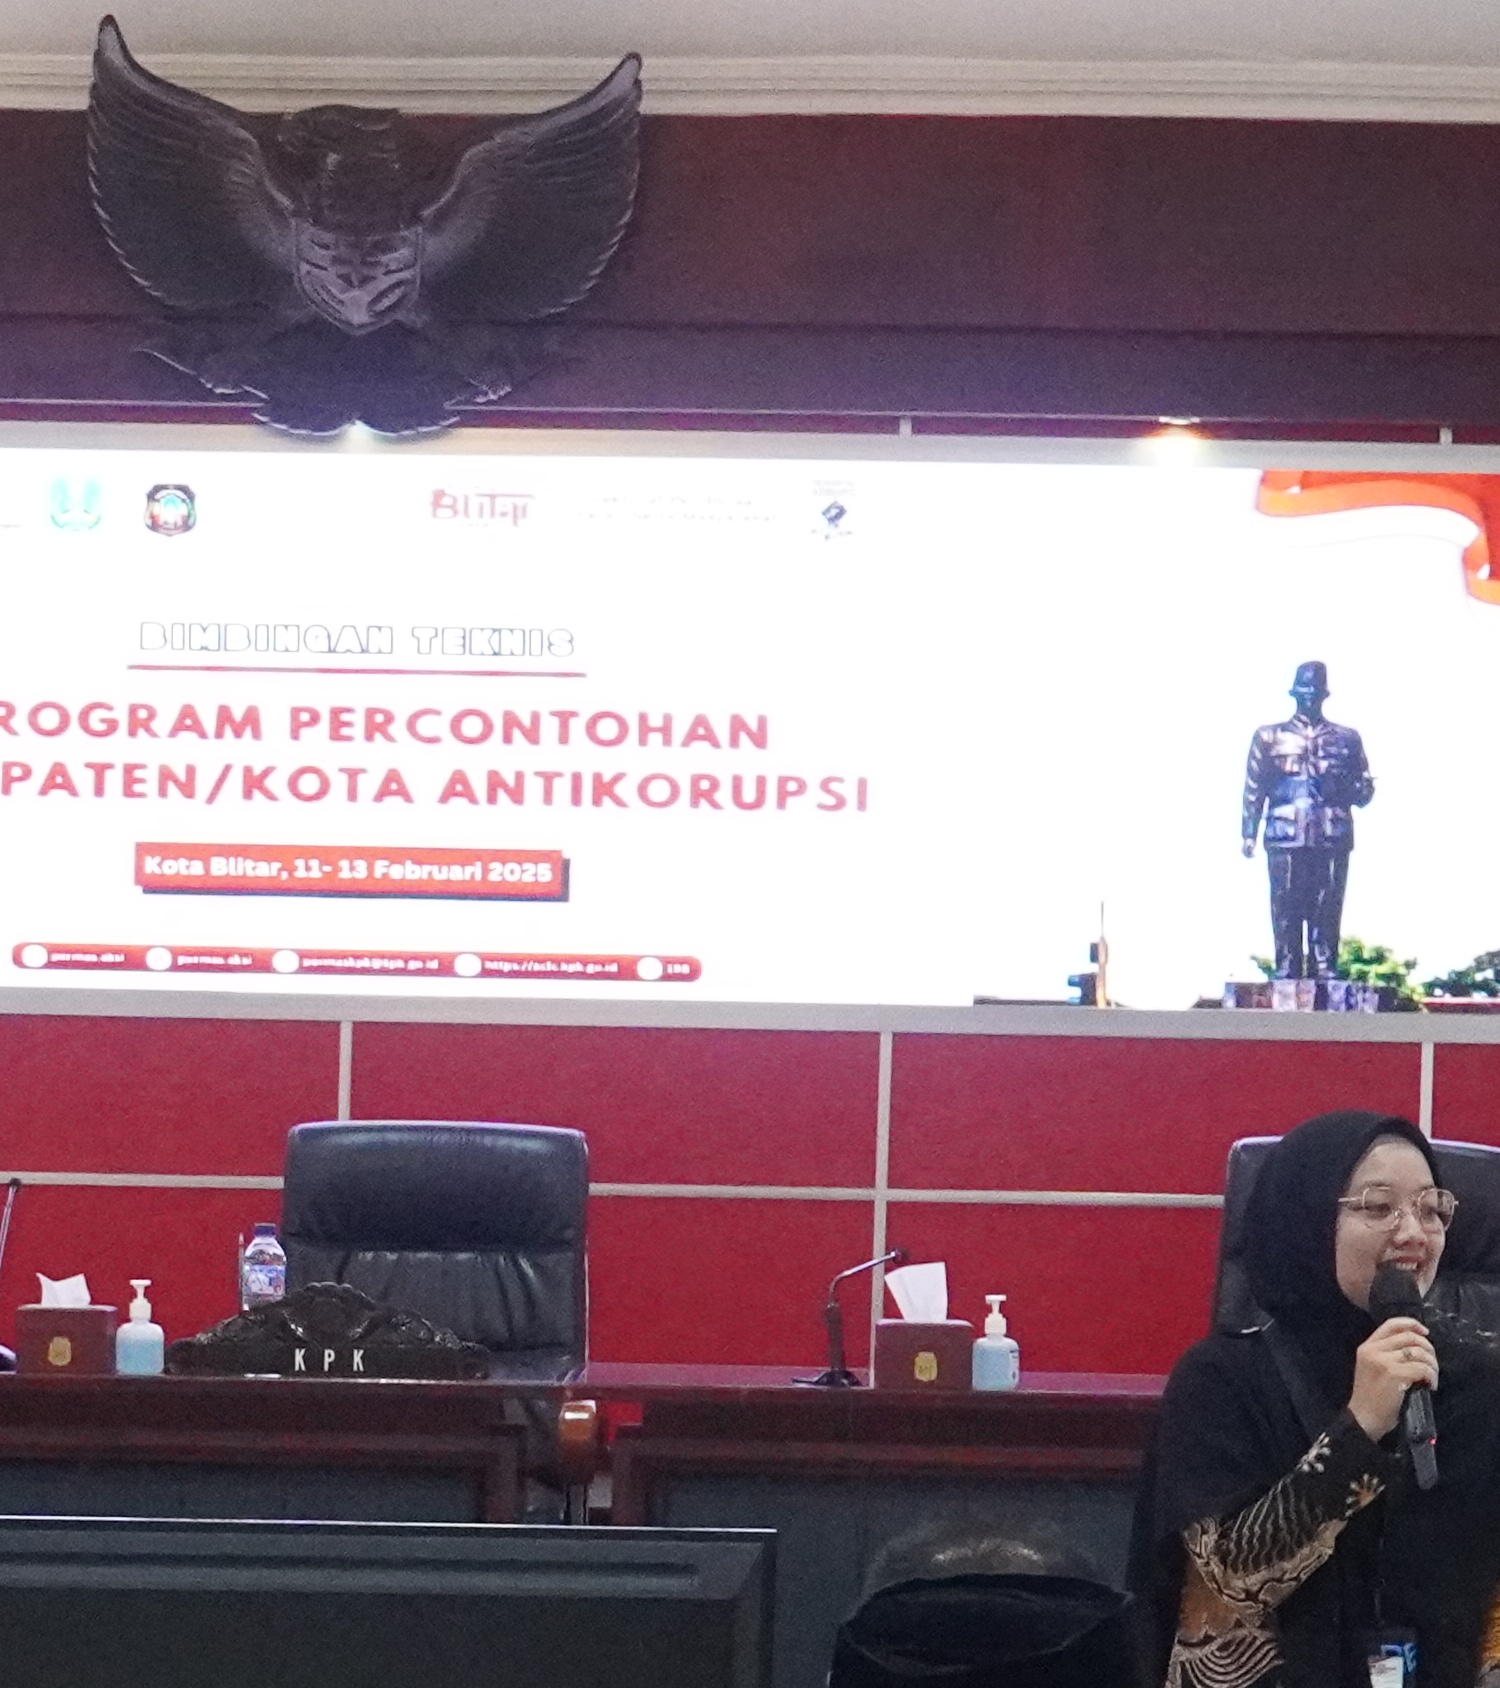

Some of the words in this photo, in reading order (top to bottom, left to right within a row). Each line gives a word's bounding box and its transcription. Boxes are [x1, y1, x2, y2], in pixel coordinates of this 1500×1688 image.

[139, 621, 394, 654] BIMBINGAN
[411, 626, 575, 657] TEKNIS
[289, 706, 769, 750] PERCONTOHAN
[437, 769, 868, 812] ANTIKORUPSI
[143, 855, 210, 877] Kota
[211, 856, 290, 881] Blitar,
[337, 859, 369, 880] 13
[374, 860, 482, 882] Februari
[487, 862, 553, 884] 2025
